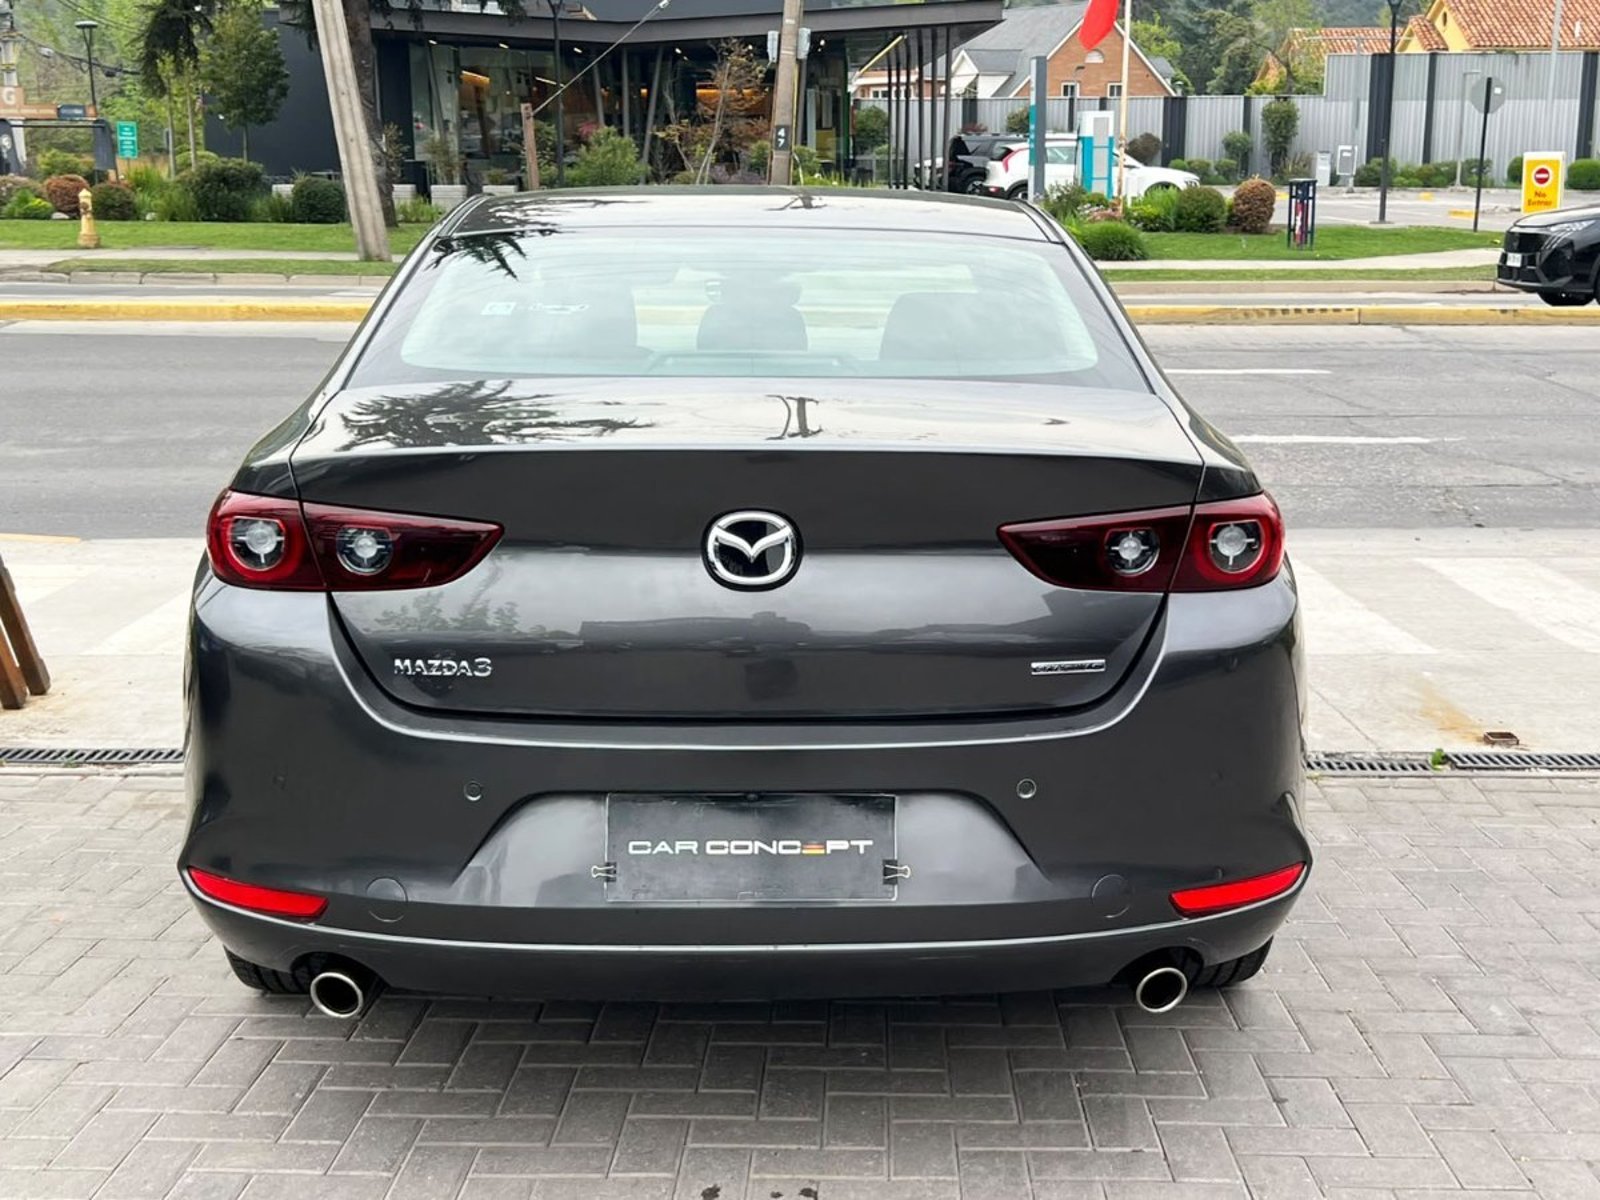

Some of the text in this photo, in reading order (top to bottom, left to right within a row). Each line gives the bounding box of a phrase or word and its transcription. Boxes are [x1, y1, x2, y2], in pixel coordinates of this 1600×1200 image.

[393, 657, 492, 677] MAZDA3
[628, 840, 874, 855] CAR CONCEPT
